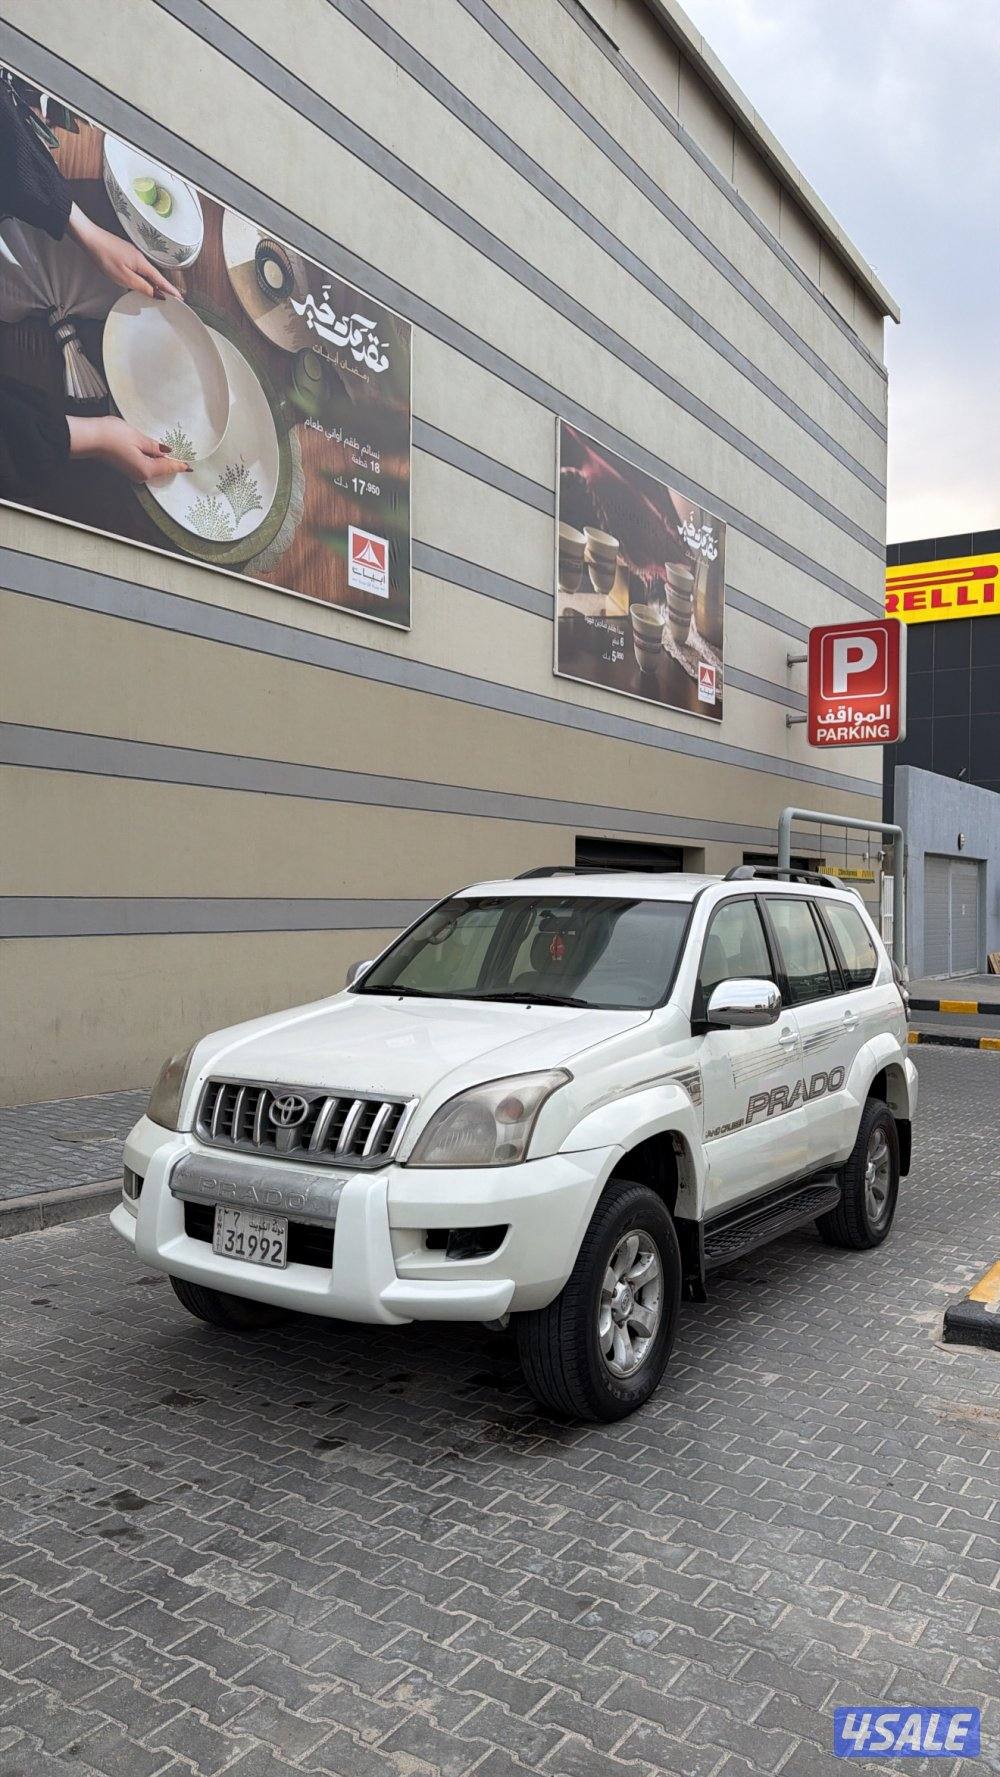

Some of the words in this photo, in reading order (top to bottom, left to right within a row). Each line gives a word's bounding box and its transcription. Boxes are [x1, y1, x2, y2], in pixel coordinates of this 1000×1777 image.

[370, 461, 380, 474] 18
[832, 636, 878, 694] P
[816, 703, 891, 726] المواقف
[816, 724, 890, 742] PARKING
[745, 1065, 846, 1125] PRADO
[199, 1175, 308, 1209] PRADO
[224, 1230, 282, 1264] 31992
